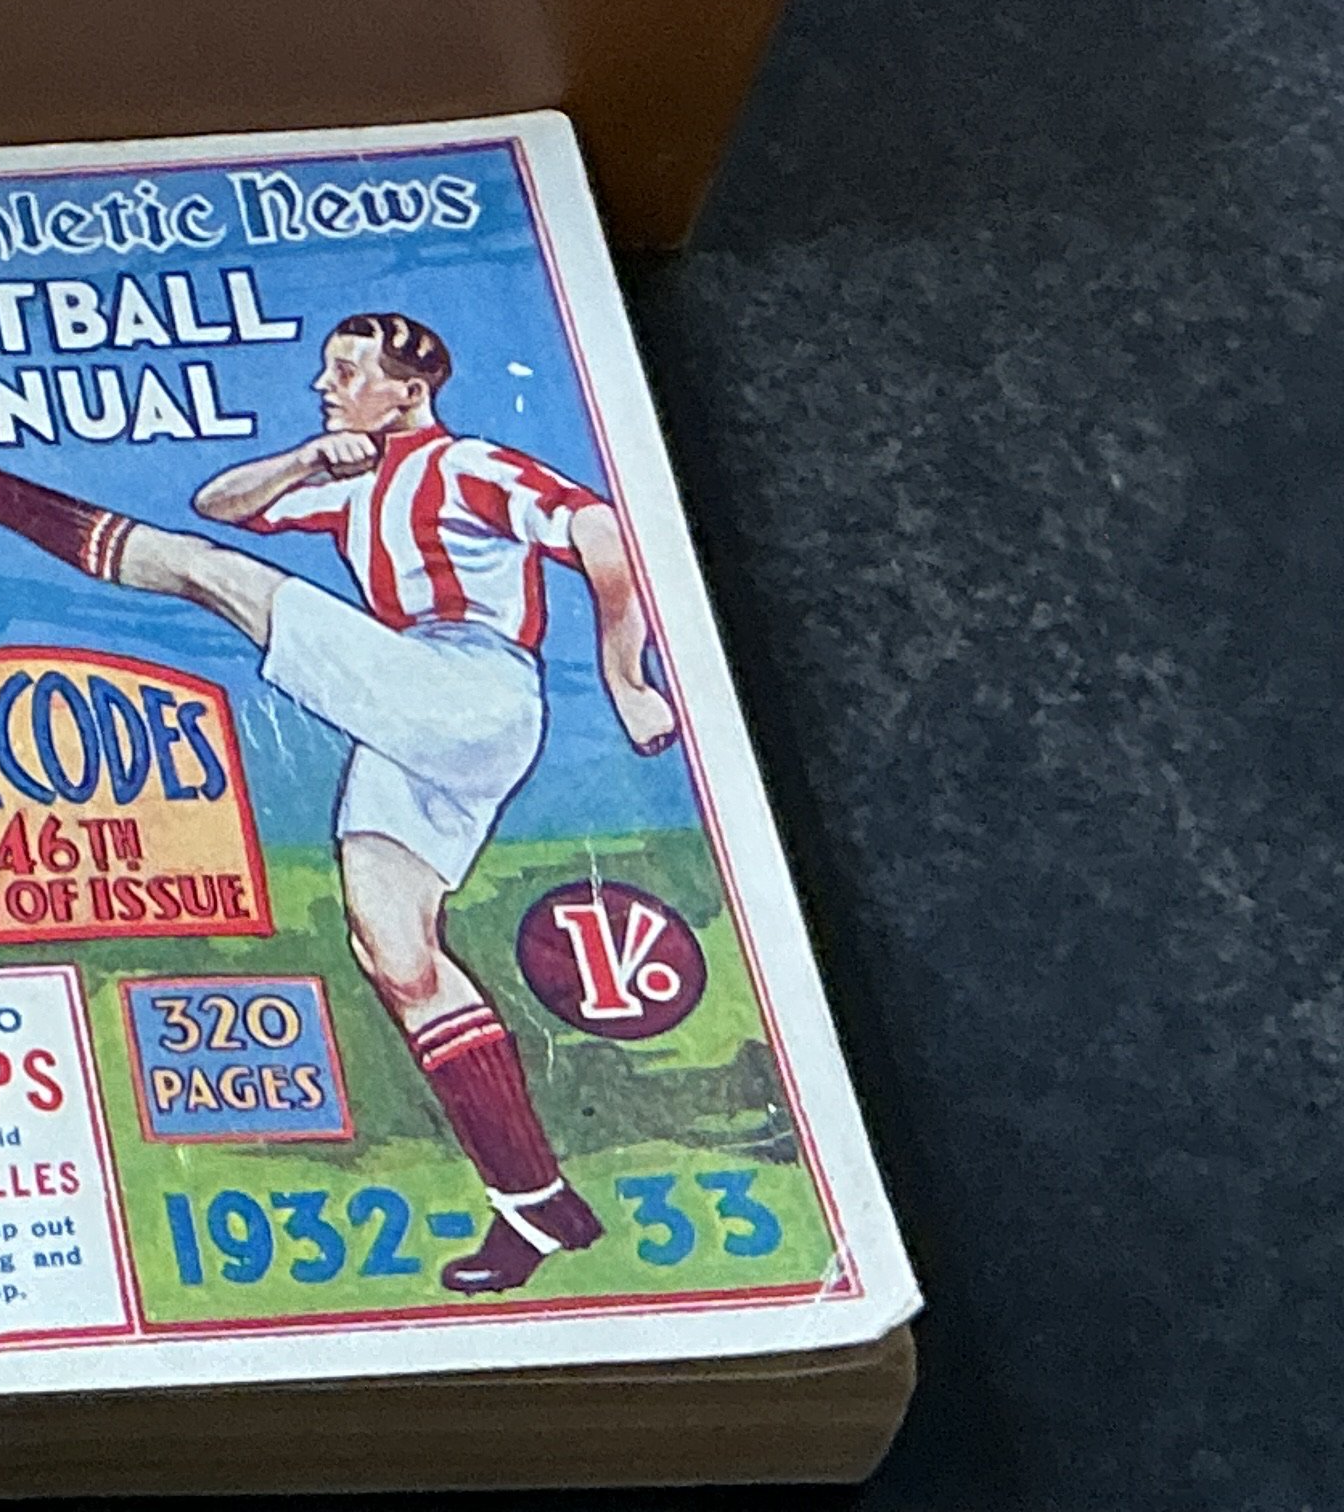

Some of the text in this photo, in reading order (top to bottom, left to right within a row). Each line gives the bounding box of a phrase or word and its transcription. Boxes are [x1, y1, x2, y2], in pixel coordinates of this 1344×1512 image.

[231, 171, 479, 247] News
[4, 876, 80, 924] OF
[87, 873, 251, 922] ISSUE
[153, 994, 302, 1051] 320
[150, 1064, 324, 1114] PAGES
[31, 1216, 76, 1238] out
[615, 1170, 782, 1266] 33
[33, 1245, 82, 1268] and
